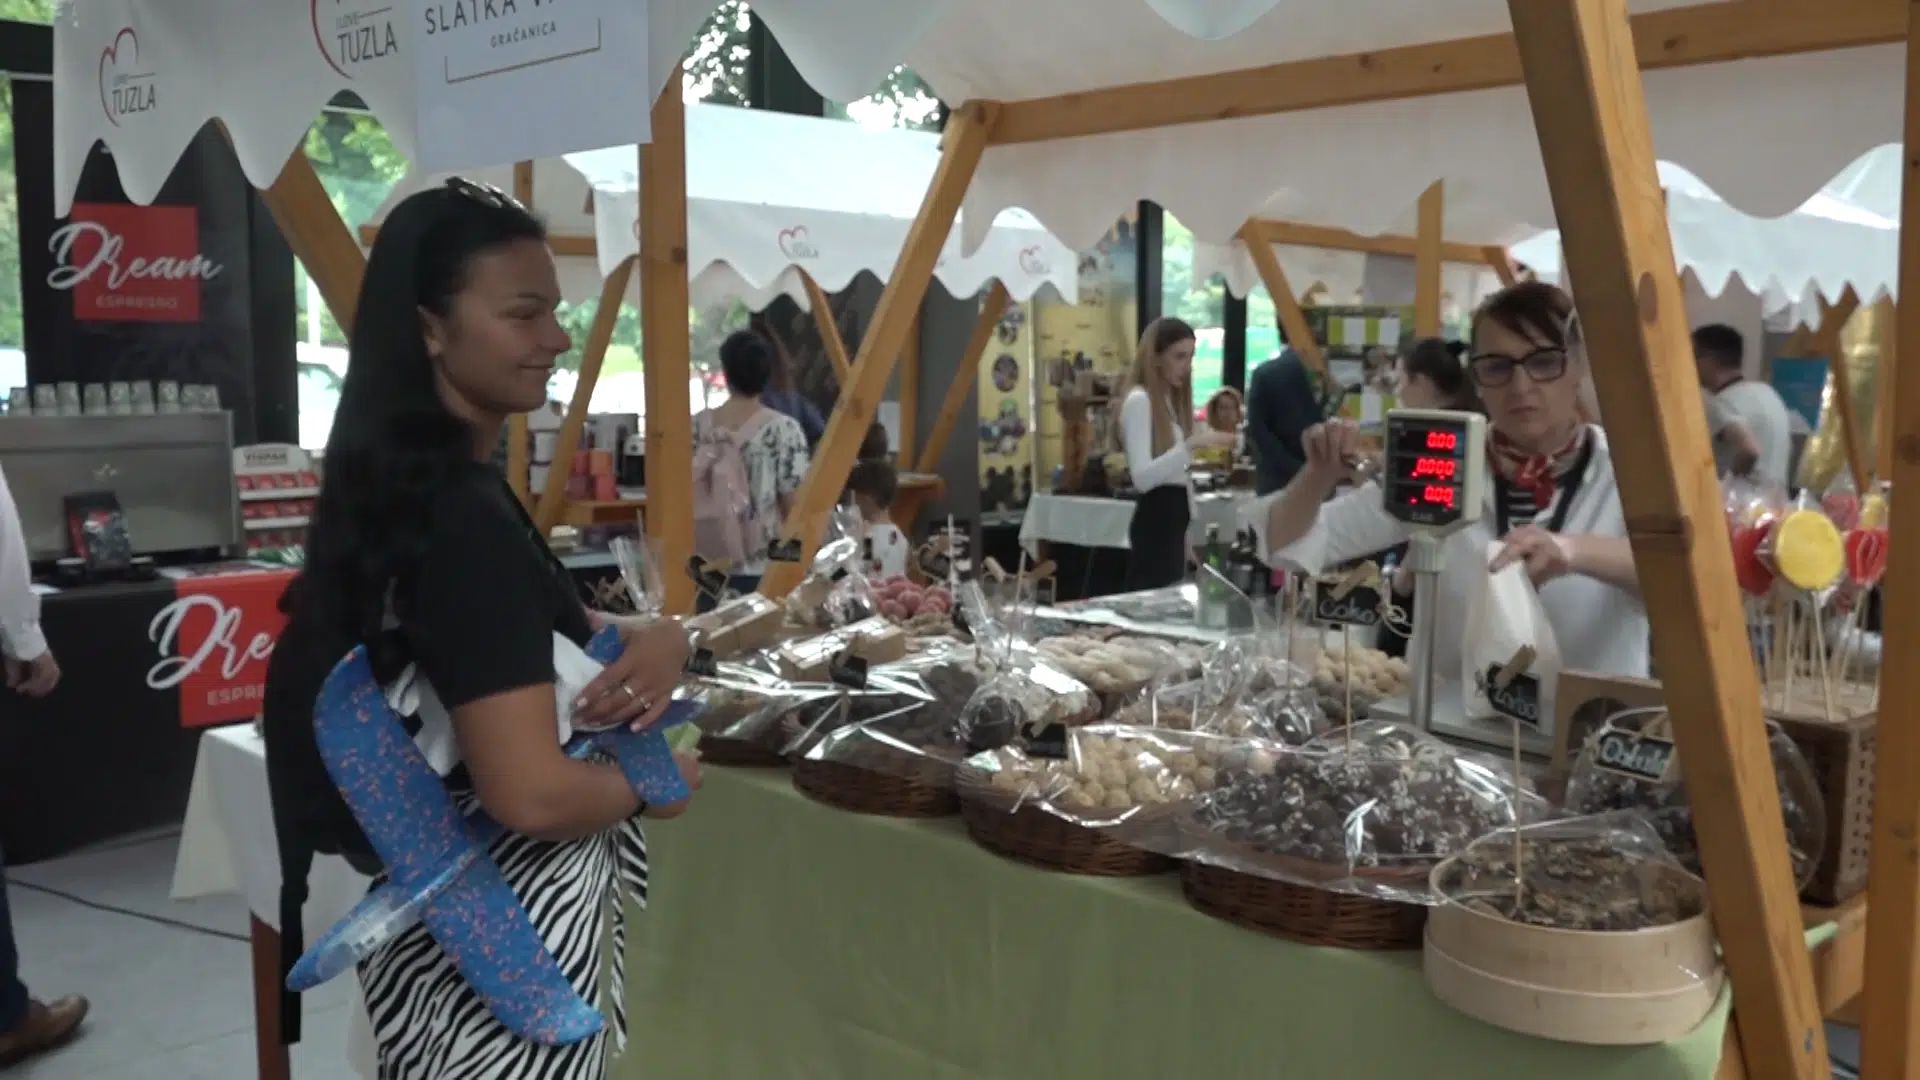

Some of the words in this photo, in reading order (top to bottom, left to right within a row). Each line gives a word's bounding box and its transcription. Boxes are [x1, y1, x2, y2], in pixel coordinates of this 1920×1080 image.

[425, 0, 516, 35] SLATKA
[490, 20, 557, 48] GRAČANICA
[337, 21, 398, 65] TUZLA
[112, 84, 156, 116] TUZLA
[46, 221, 224, 290] Dream
[95, 295, 178, 309] ESPRESSO
[146, 593, 276, 690] Dre
[207, 683, 265, 706] ESPRE
